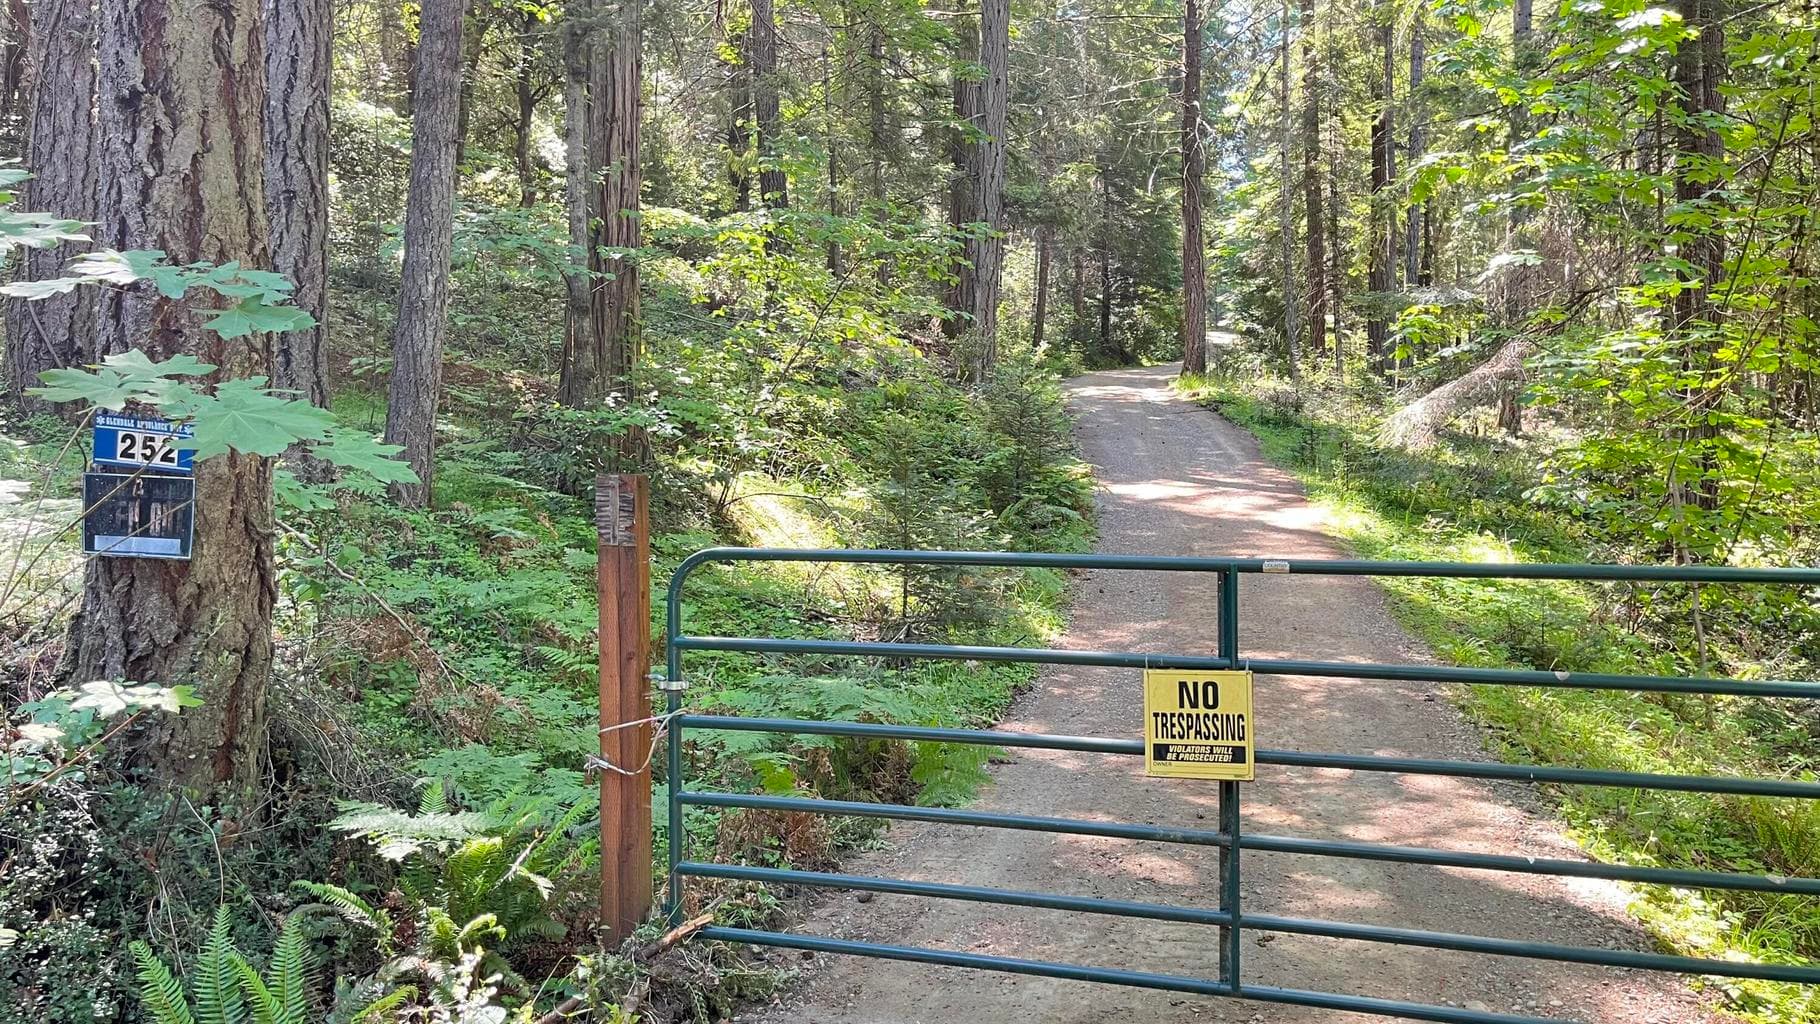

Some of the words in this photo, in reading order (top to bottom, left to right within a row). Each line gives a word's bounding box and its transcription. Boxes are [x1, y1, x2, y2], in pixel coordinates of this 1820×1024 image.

[106, 417, 134, 427] GLENDALE
[137, 420, 168, 431] AMBULANCE
[120, 433, 176, 463] 252
[1178, 681, 1219, 709] NO
[1153, 712, 1245, 741] TRESPASSING
[1169, 745, 1211, 754] VIOLATORS
[1213, 746, 1233, 754] WILL
[1179, 753, 1232, 762] PROSECUTED!
